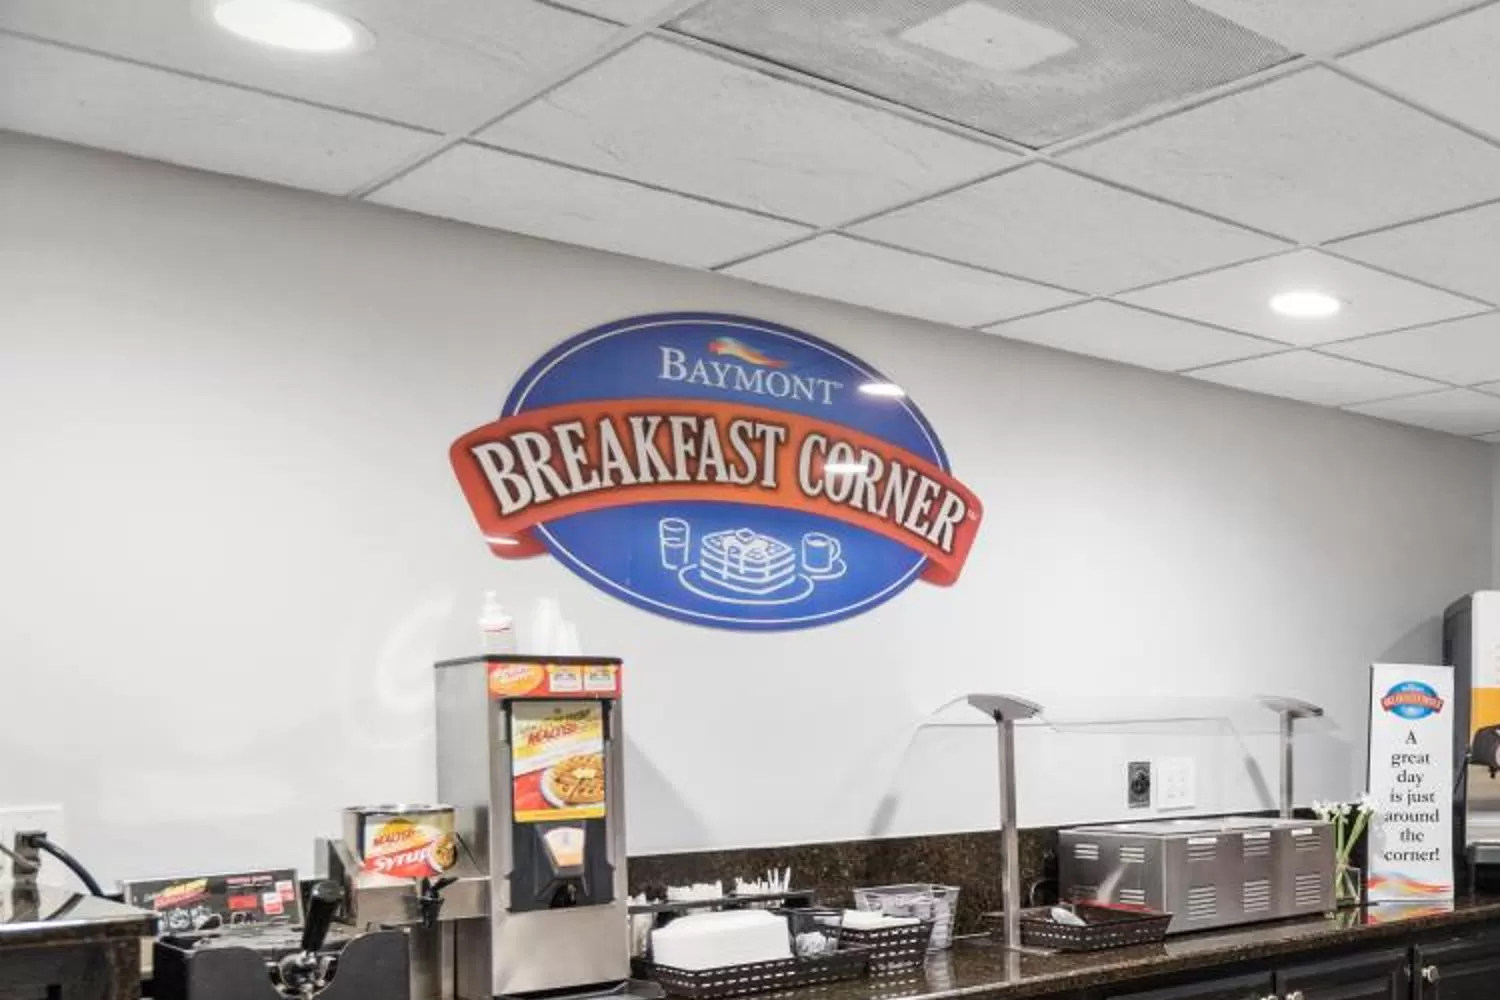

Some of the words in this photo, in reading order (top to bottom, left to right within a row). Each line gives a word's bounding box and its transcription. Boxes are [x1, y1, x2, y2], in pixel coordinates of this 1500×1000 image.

[658, 346, 840, 406] BAYMONT
[472, 414, 787, 517] BREAKFAST
[799, 432, 968, 553] CORNER
[1405, 730, 1418, 745] A
[1391, 753, 1431, 768] great
[1397, 769, 1425, 788] day
[1390, 790, 1403, 804] is
[1406, 790, 1436, 809] just
[1384, 808, 1440, 823] around
[1399, 827, 1425, 843] the
[1384, 847, 1441, 862] corner!
